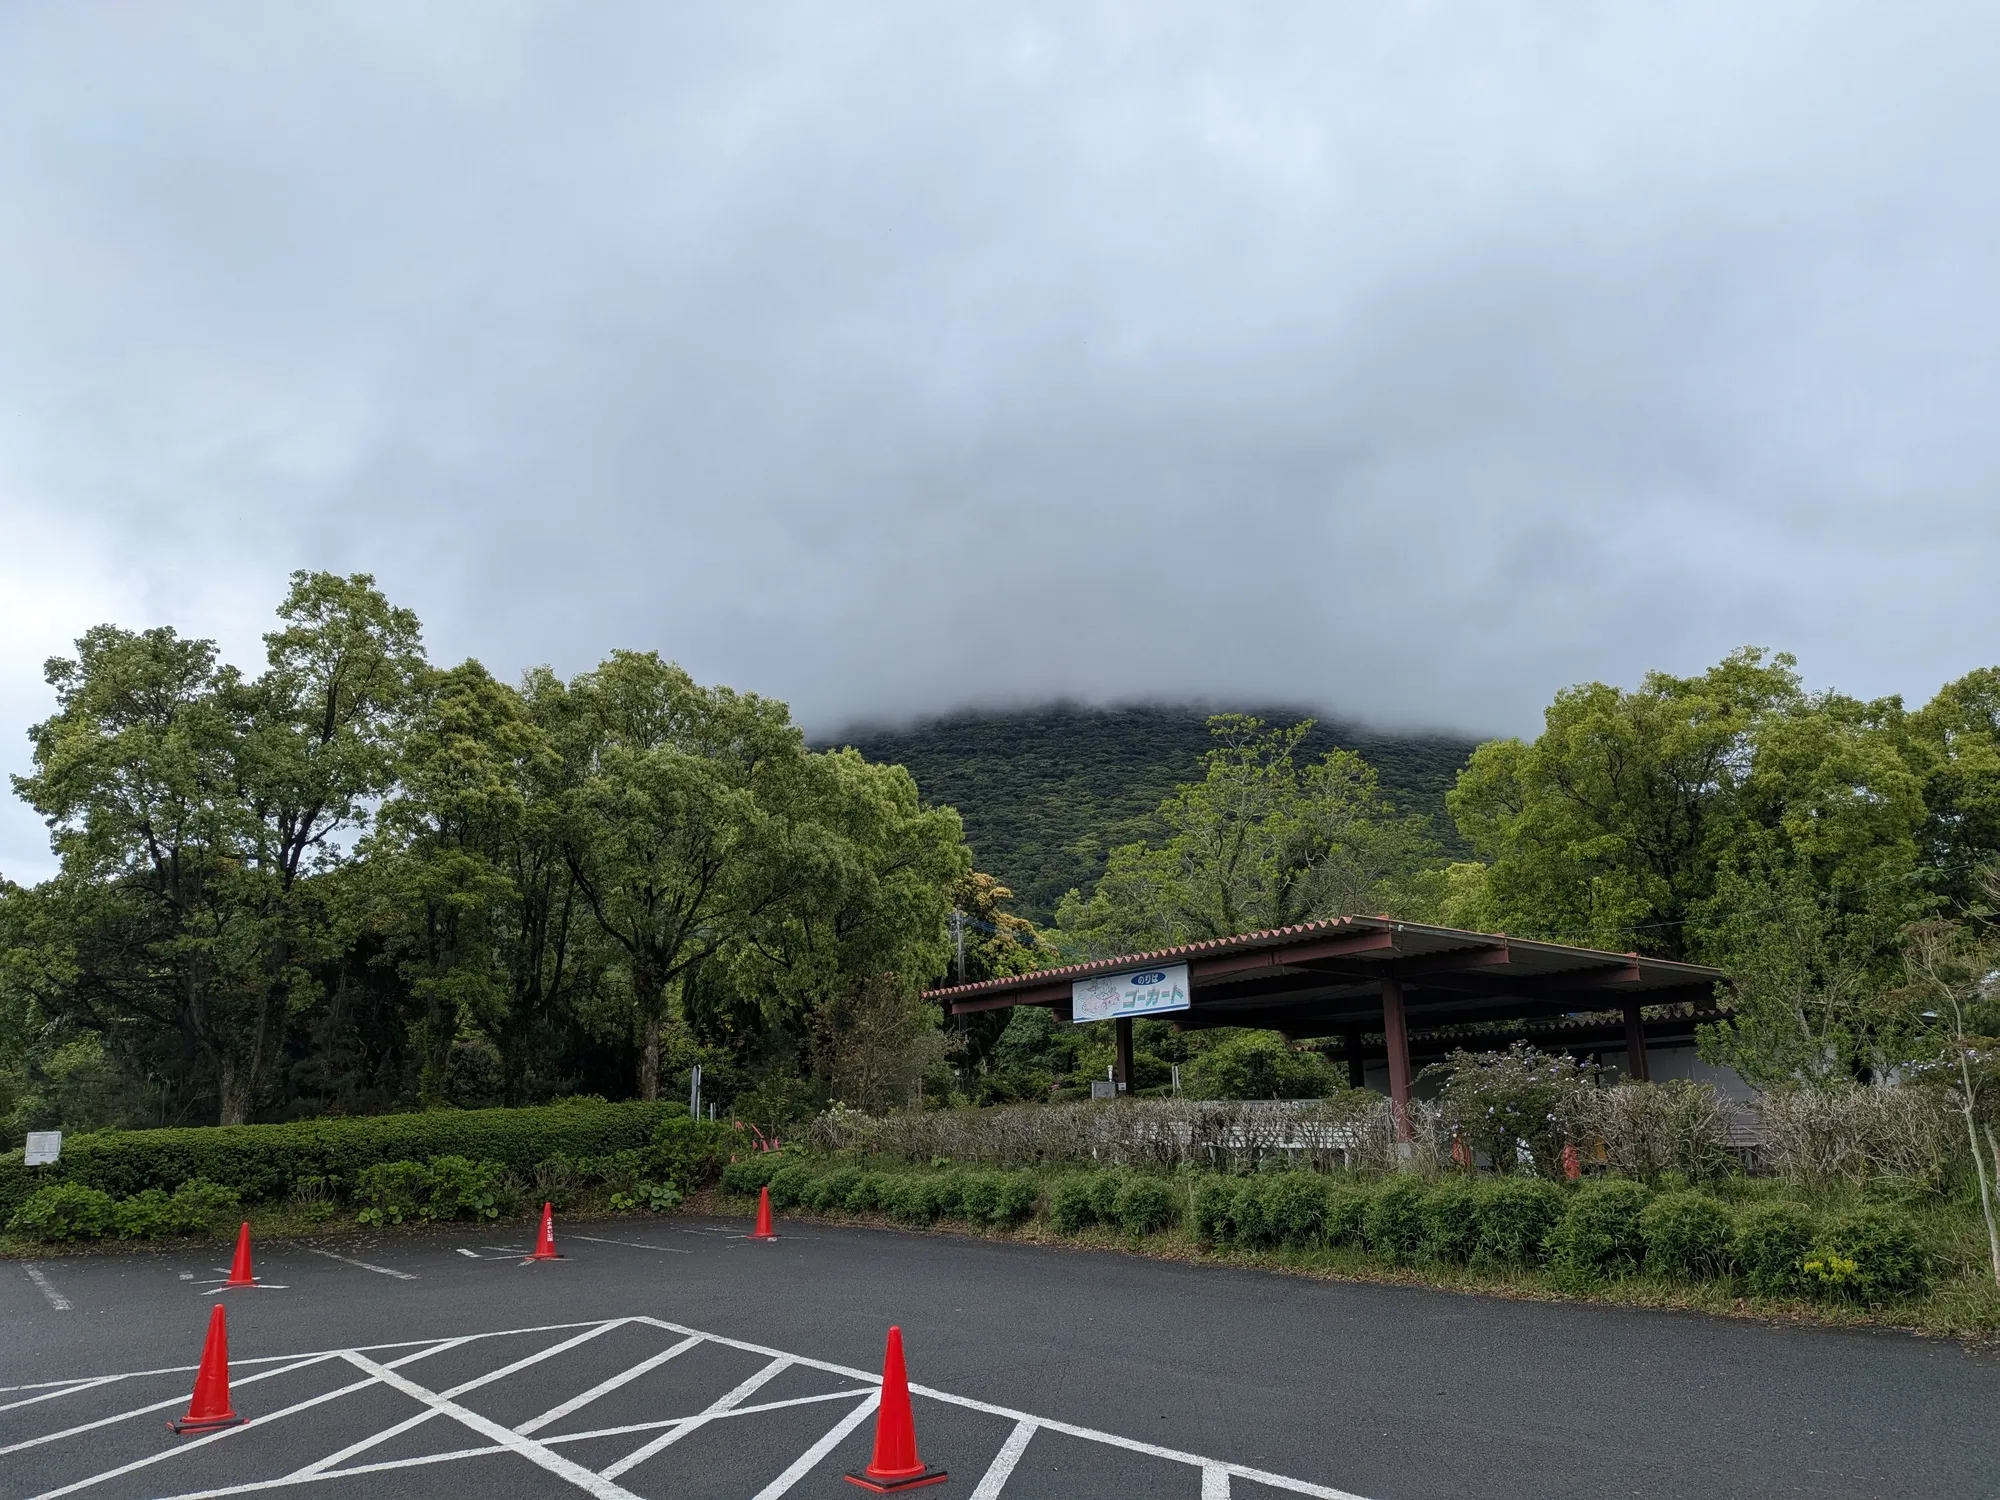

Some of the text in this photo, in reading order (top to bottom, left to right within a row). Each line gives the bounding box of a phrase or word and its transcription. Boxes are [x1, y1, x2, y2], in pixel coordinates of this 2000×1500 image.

[1137, 973, 1159, 985] のりば
[1122, 982, 1184, 1009] ゴーカート
